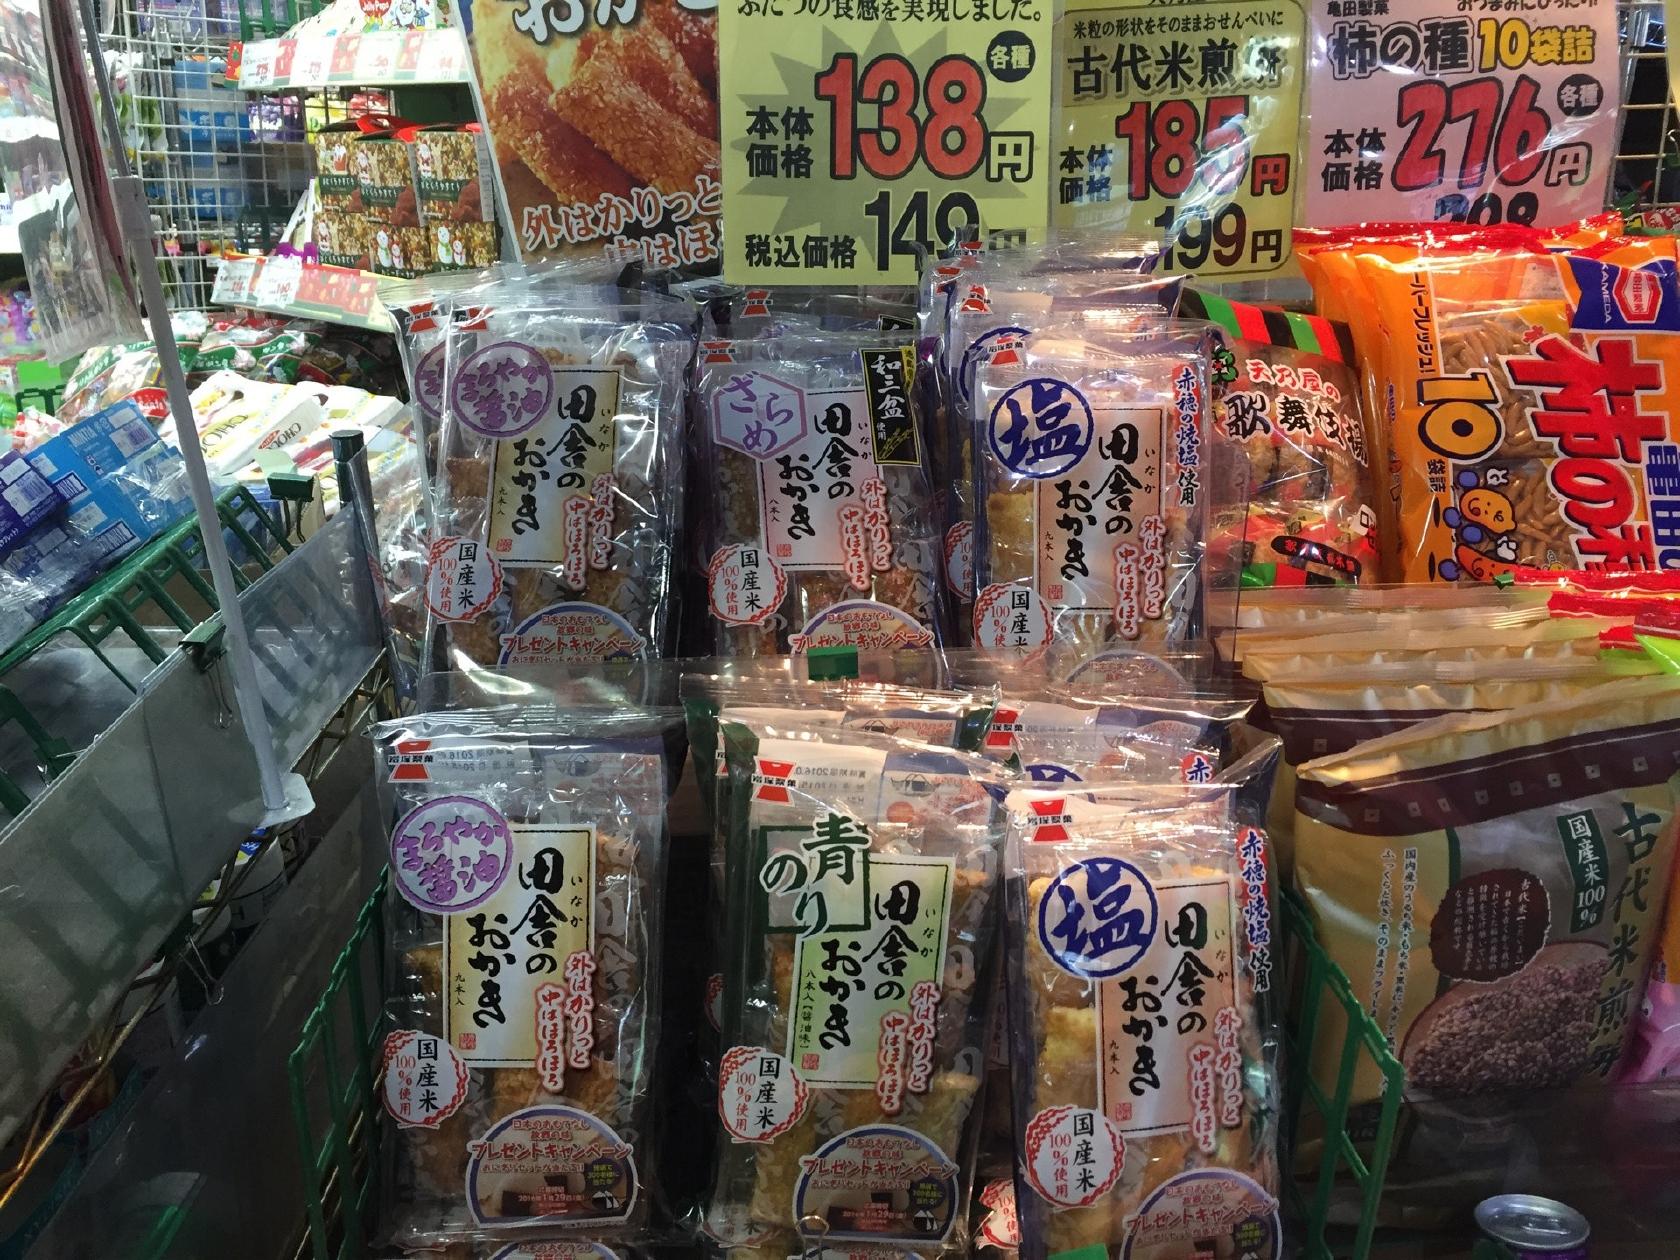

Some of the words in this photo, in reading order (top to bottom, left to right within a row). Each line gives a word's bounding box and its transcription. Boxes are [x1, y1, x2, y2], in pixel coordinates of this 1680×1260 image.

[990, 45, 1031, 70] 各種
[1073, 10, 1284, 39] 米粒の形状をそのままおせんべいに
[1333, 22, 1473, 78] 柿の種
[746, 106, 814, 141] 本体
[1560, 83, 1600, 108] 各種
[745, 144, 814, 179] 価格
[1321, 161, 1384, 191] 価格
[1323, 128, 1387, 158] 本体
[745, 235, 857, 268] 税込価格
[1408, 262, 1434, 374] ーパーフレッシュ!
[1601, 263, 1612, 324] KAMEDA
[547, 384, 598, 489] 田舎の
[718, 370, 795, 452] ざらめ
[813, 402, 859, 499] 田舎の
[999, 377, 1083, 466] 塩
[512, 438, 549, 535] おかき
[775, 454, 820, 540] おかき
[1093, 422, 1143, 535] 田舎の
[1055, 479, 1097, 581] おかき
[457, 542, 478, 609] 国産米
[740, 549, 761, 612] 国産米
[509, 847, 568, 976] 田舎の
[570, 875, 583, 928] いなか
[863, 880, 921, 1001] 田舎の
[1051, 859, 1148, 960] 塩
[1241, 829, 1271, 992] 赤穂の焼塩使用
[466, 912, 516, 1028] おかき
[819, 938, 866, 1050] おかき
[1161, 902, 1214, 1036] 田舎の
[416, 1038, 439, 1114] 国産米
[1119, 975, 1168, 1097] おかき
[755, 1056, 780, 1130] 国産米
[1073, 1112, 1097, 1194] 国産米
